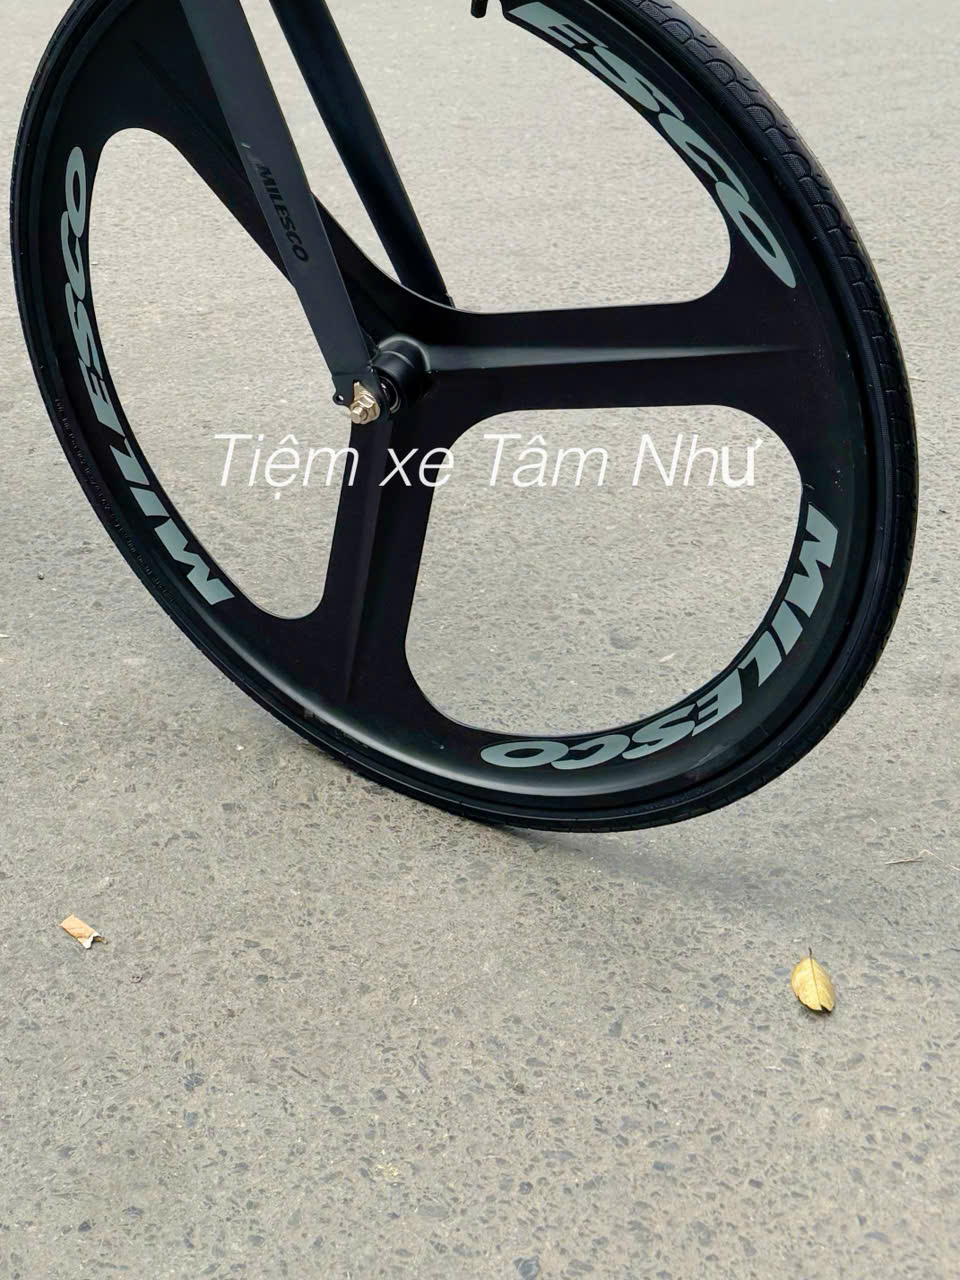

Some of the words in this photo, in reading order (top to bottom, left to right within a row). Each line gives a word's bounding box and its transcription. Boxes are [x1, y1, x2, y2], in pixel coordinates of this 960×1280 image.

[257, 163, 309, 262] MILESCO
[60, 146, 236, 606] MILESCO
[480, 502, 839, 771] MILESCO
